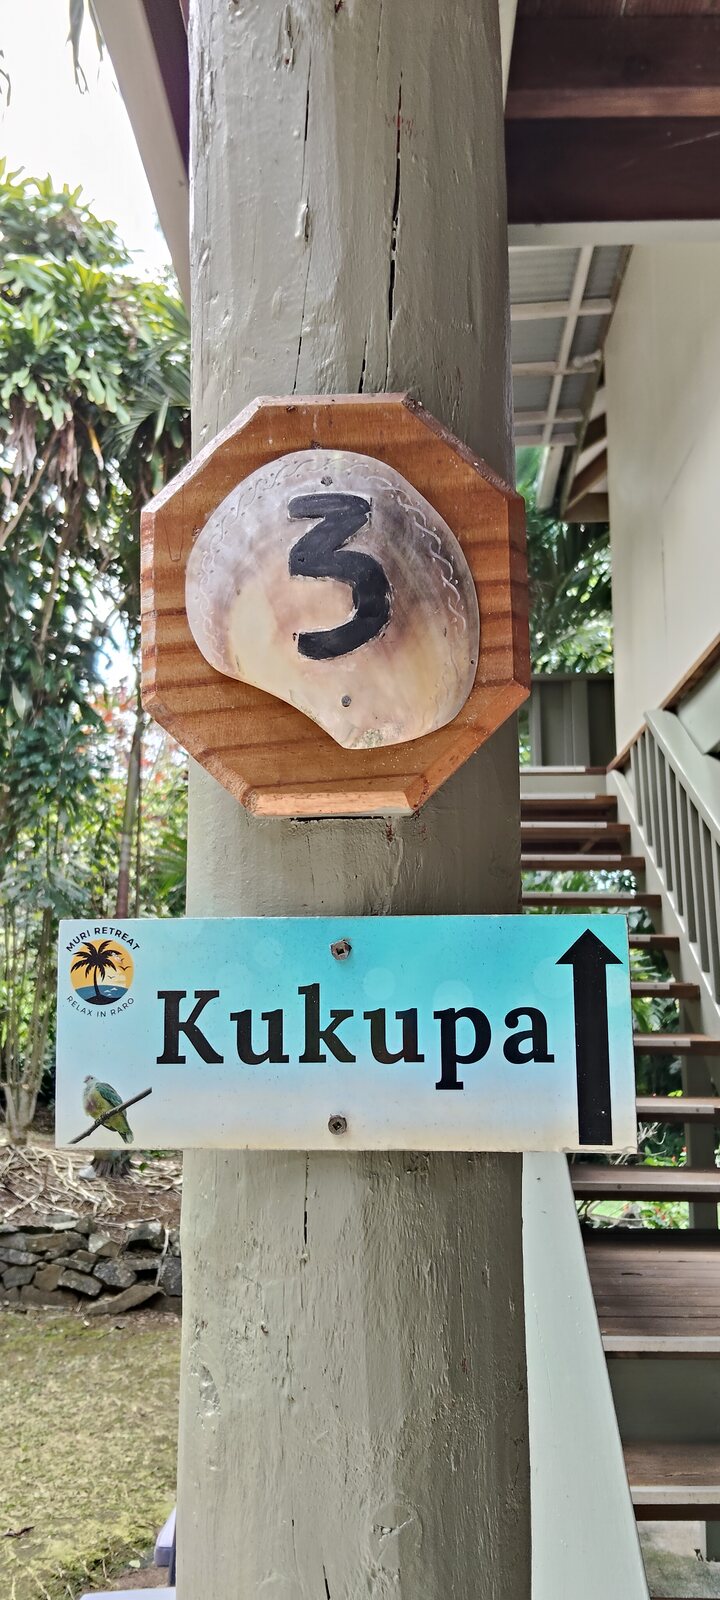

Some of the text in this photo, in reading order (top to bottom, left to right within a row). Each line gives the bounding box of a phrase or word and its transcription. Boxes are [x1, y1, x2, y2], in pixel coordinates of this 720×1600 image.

[288, 492, 391, 660] 3
[66, 926, 141, 952] MURI RETREAT
[66, 995, 93, 1017] RELAX
[110, 997, 135, 1016] RARO
[156, 983, 555, 1090] Kukupa
